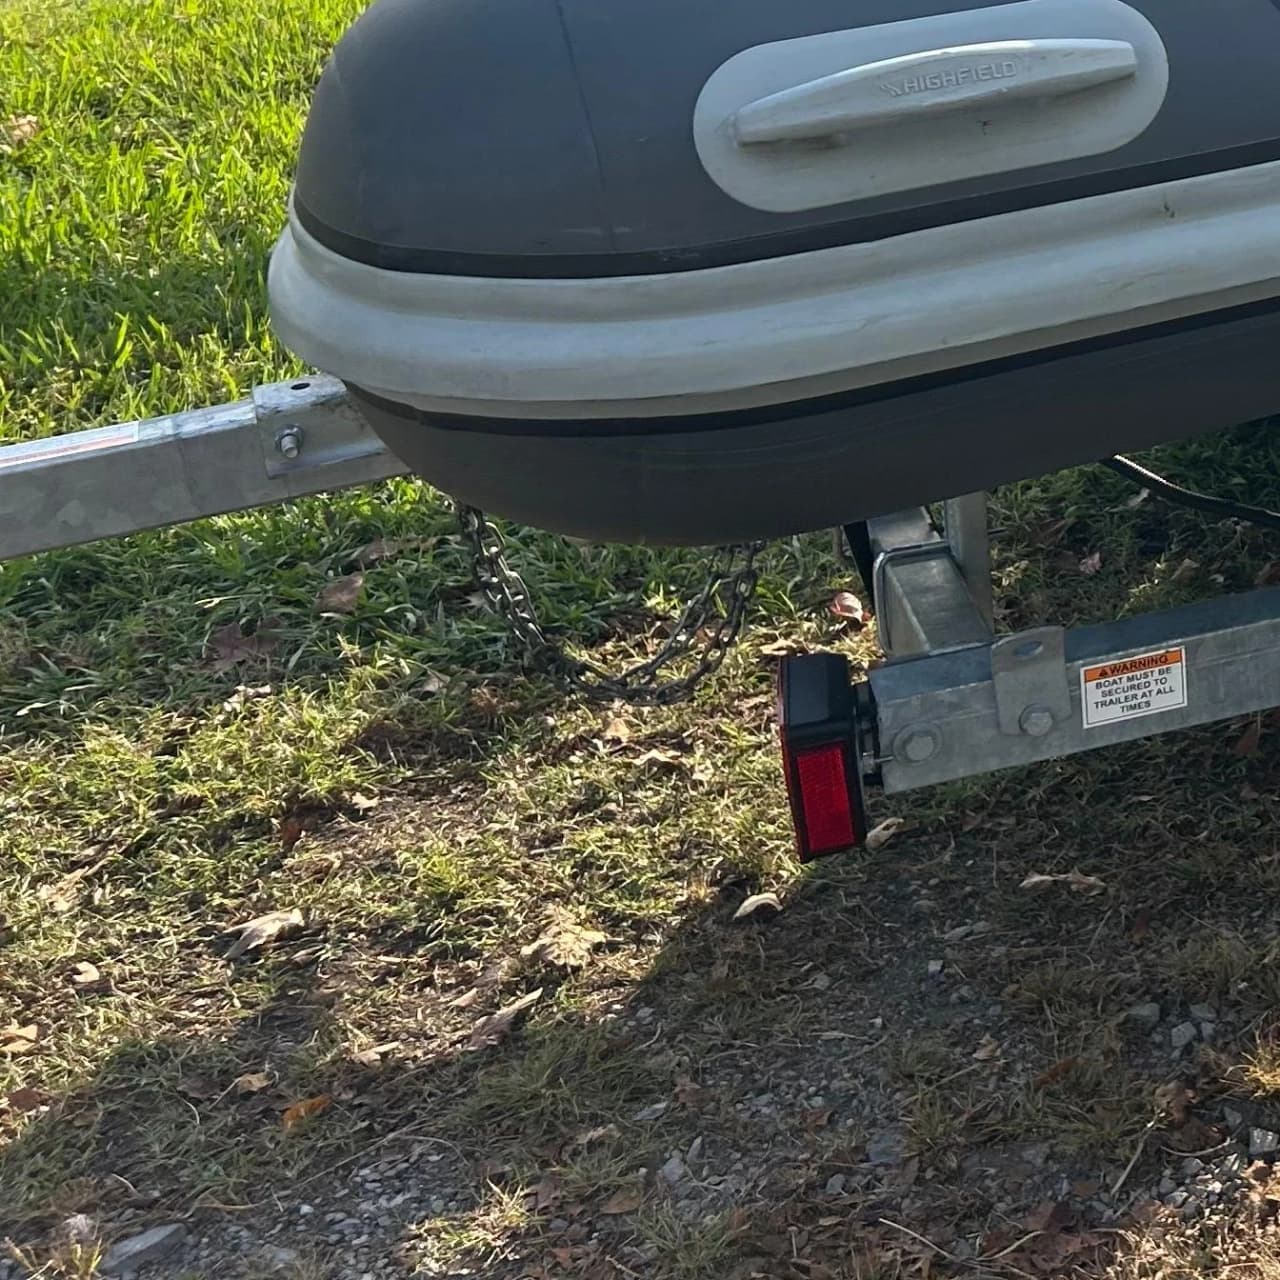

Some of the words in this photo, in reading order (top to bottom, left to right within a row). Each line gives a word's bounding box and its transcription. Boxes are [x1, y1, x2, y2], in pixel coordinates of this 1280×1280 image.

[903, 61, 1016, 95] HIGHFIELD
[1108, 655, 1168, 674] WARNING
[1096, 677, 1123, 690] BOAT
[1127, 670, 1156, 683] MUST
[1101, 681, 1151, 698] SECURED
[1153, 677, 1168, 686] TO
[1094, 694, 1138, 709] TRAILER
[1141, 690, 1154, 700] AT
[1156, 686, 1175, 696] ALL
[1120, 701, 1151, 713] TIMES
